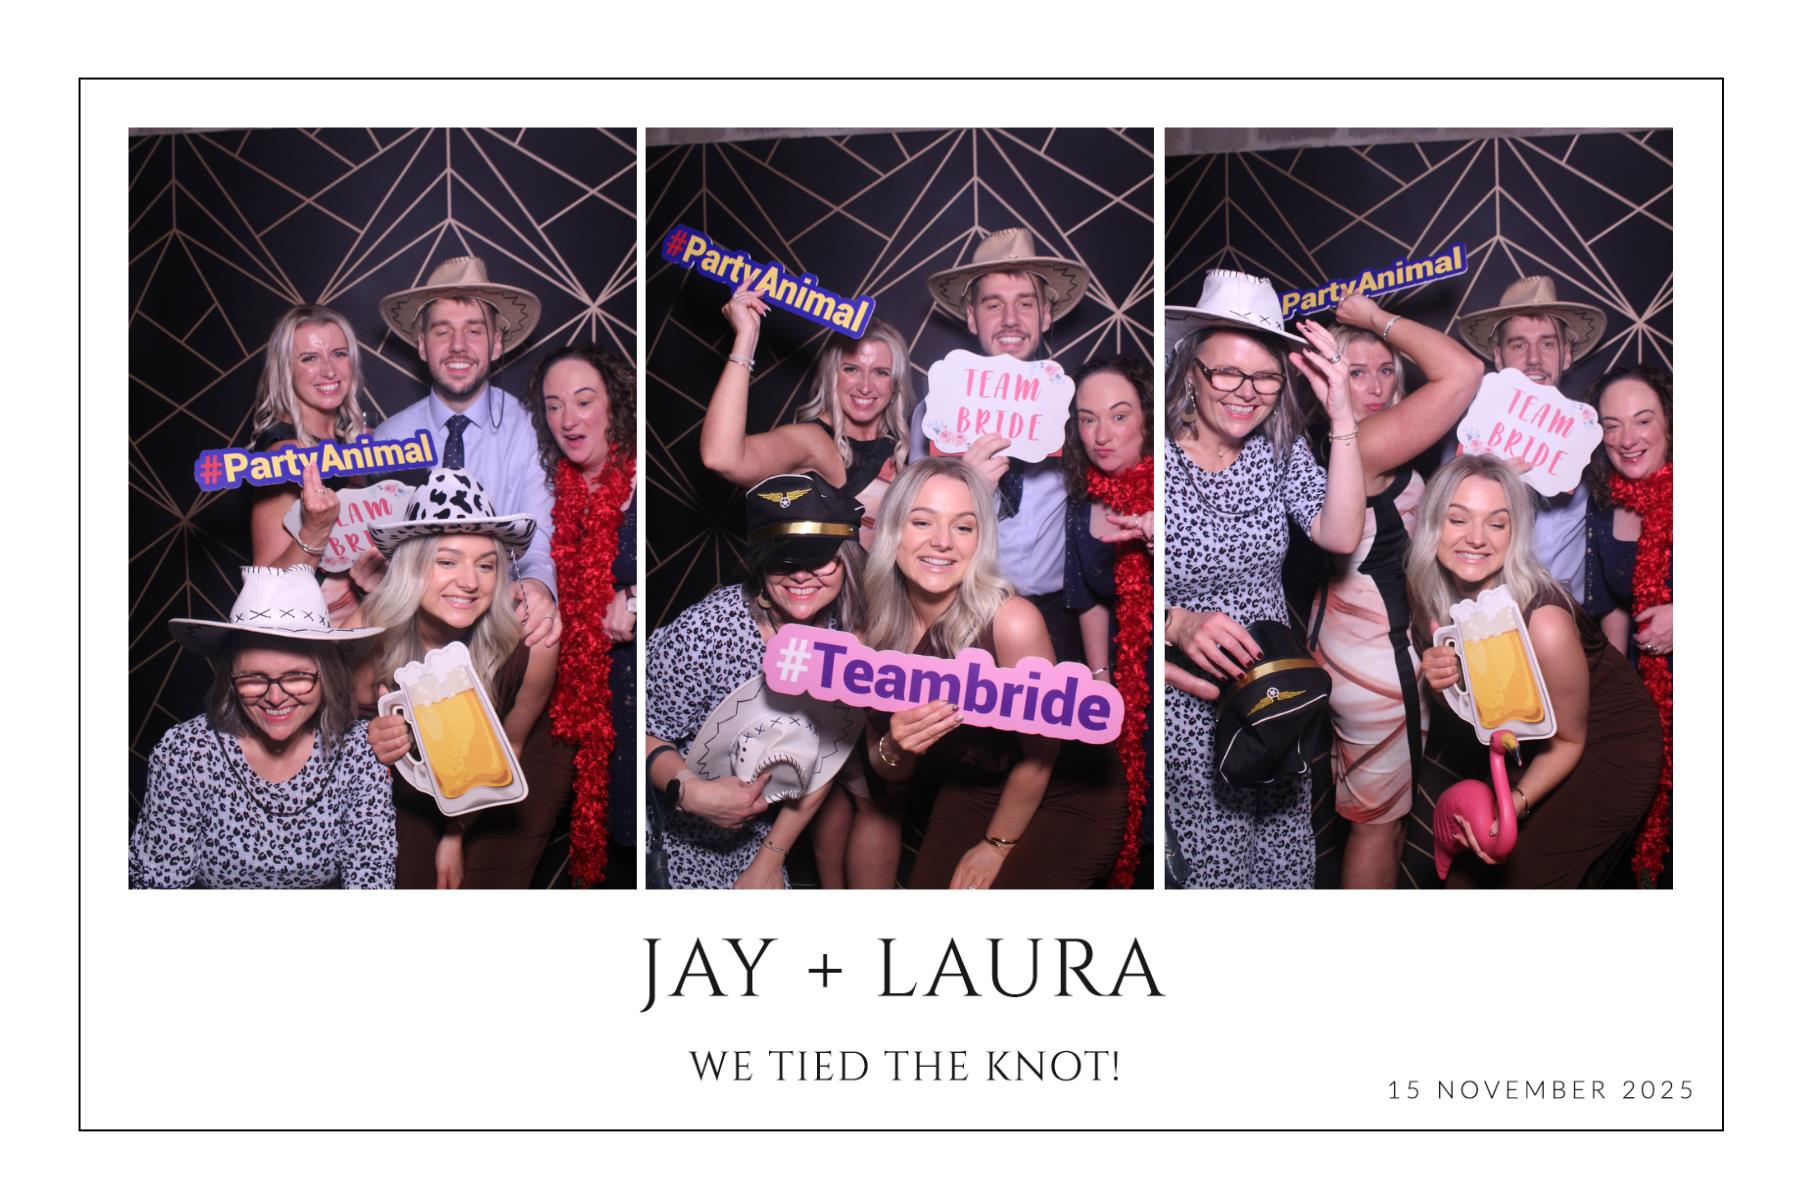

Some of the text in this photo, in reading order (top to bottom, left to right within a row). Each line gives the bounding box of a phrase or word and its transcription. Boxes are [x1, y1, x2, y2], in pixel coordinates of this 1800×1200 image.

[665, 229, 870, 333] #PartyAnimal
[1282, 246, 1462, 316] PartAnimal
[963, 368, 1042, 402] TEAM
[956, 406, 1044, 441] BRIDE
[1507, 387, 1575, 439] TEAM
[200, 433, 433, 486] #PartyAnimal
[1487, 421, 1569, 476] BRIDE
[328, 530, 377, 556] BRI
[776, 637, 1111, 731] #Teambride
